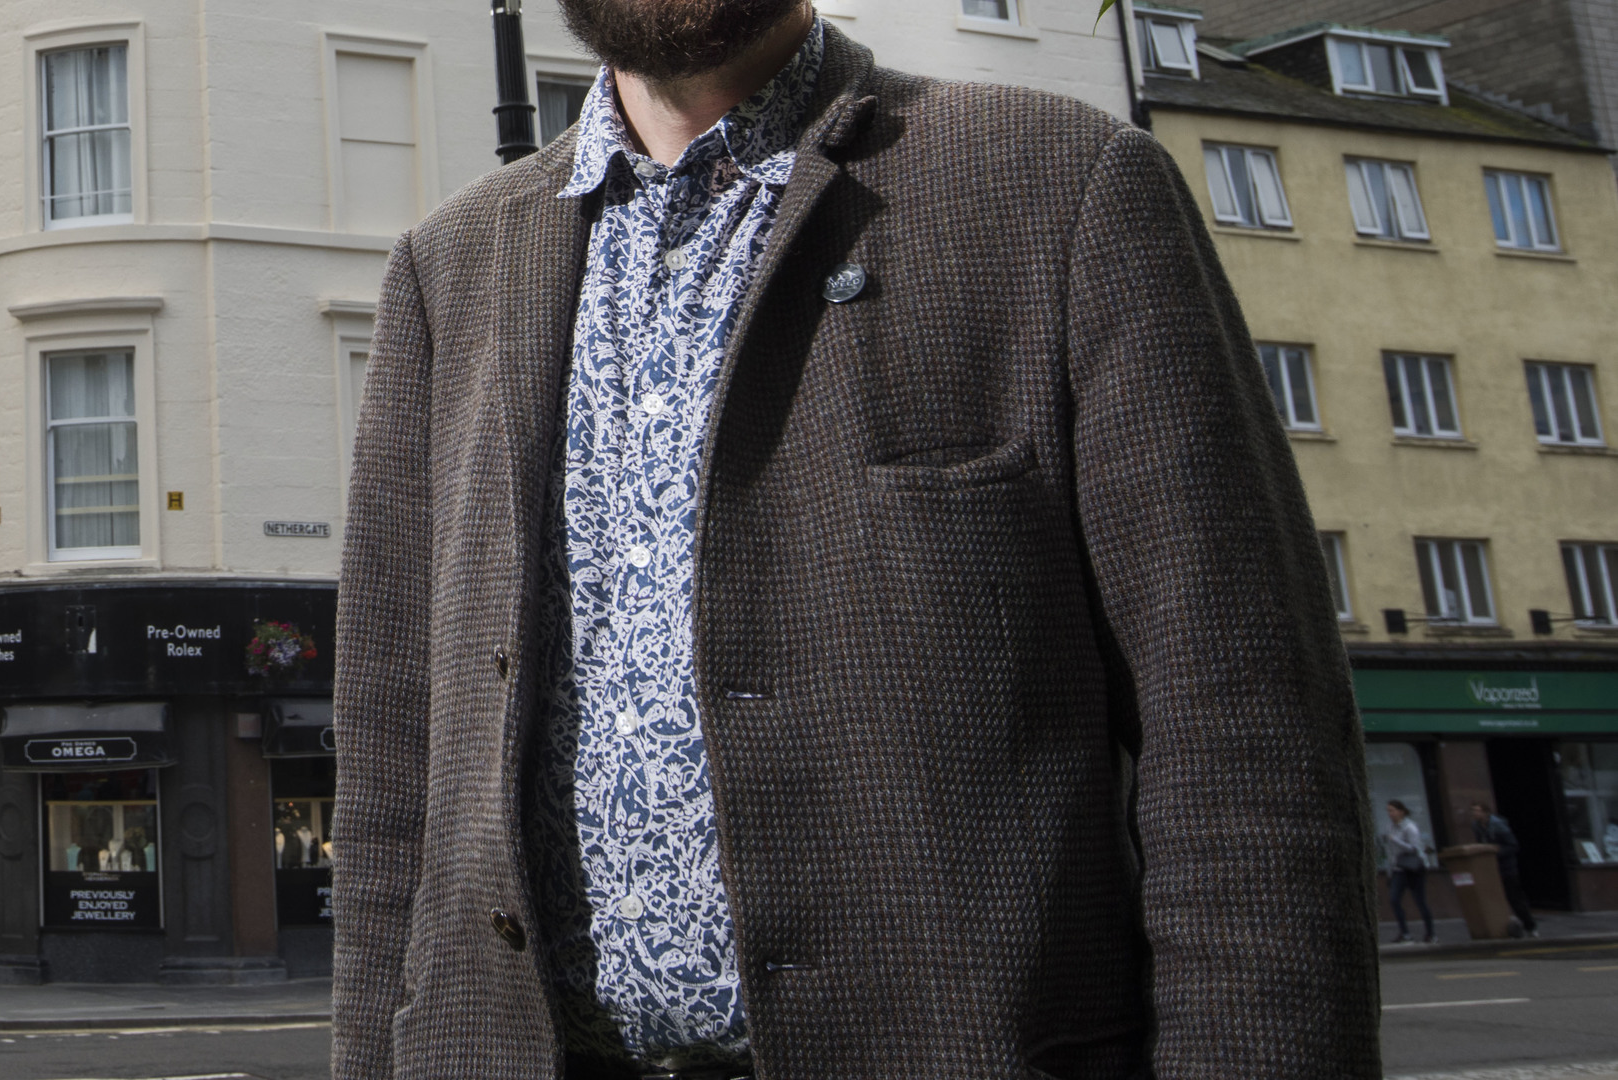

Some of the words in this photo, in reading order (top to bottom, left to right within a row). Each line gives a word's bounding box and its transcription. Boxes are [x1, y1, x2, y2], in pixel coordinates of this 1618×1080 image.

[267, 523, 328, 536] NETHERGATE
[146, 624, 222, 639] Pre-Owned
[166, 642, 203, 657] Rolex
[51, 745, 106, 757] OMEGA
[70, 890, 136, 900] PREVIOUSLY
[78, 900, 129, 910] ENJOYED
[71, 911, 136, 920] JEWELLERY
